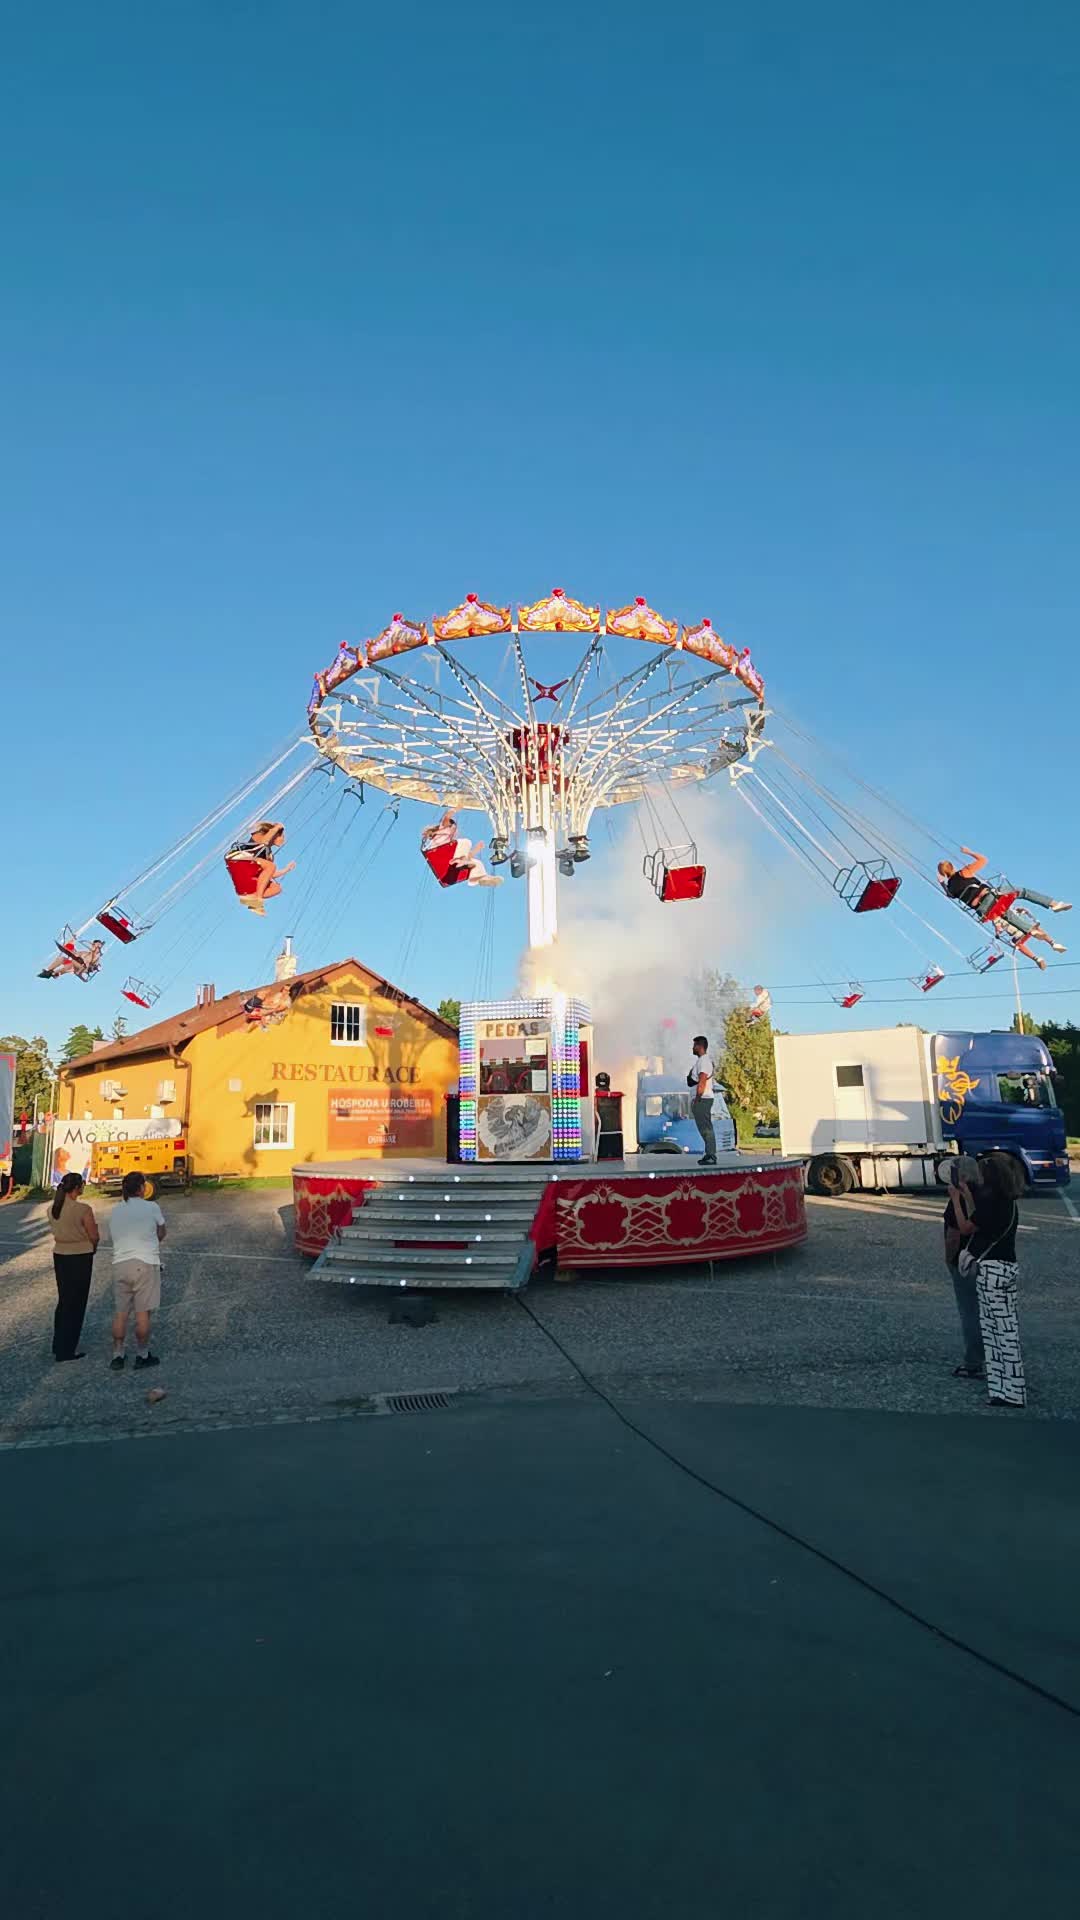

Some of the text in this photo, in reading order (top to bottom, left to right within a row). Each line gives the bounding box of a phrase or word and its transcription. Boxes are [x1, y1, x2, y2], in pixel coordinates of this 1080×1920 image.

[486, 1022, 539, 1037] PEGAS
[271, 1062, 421, 1083] RESTAURACE
[331, 1098, 432, 1109] HOSPODA U ROBERTA
